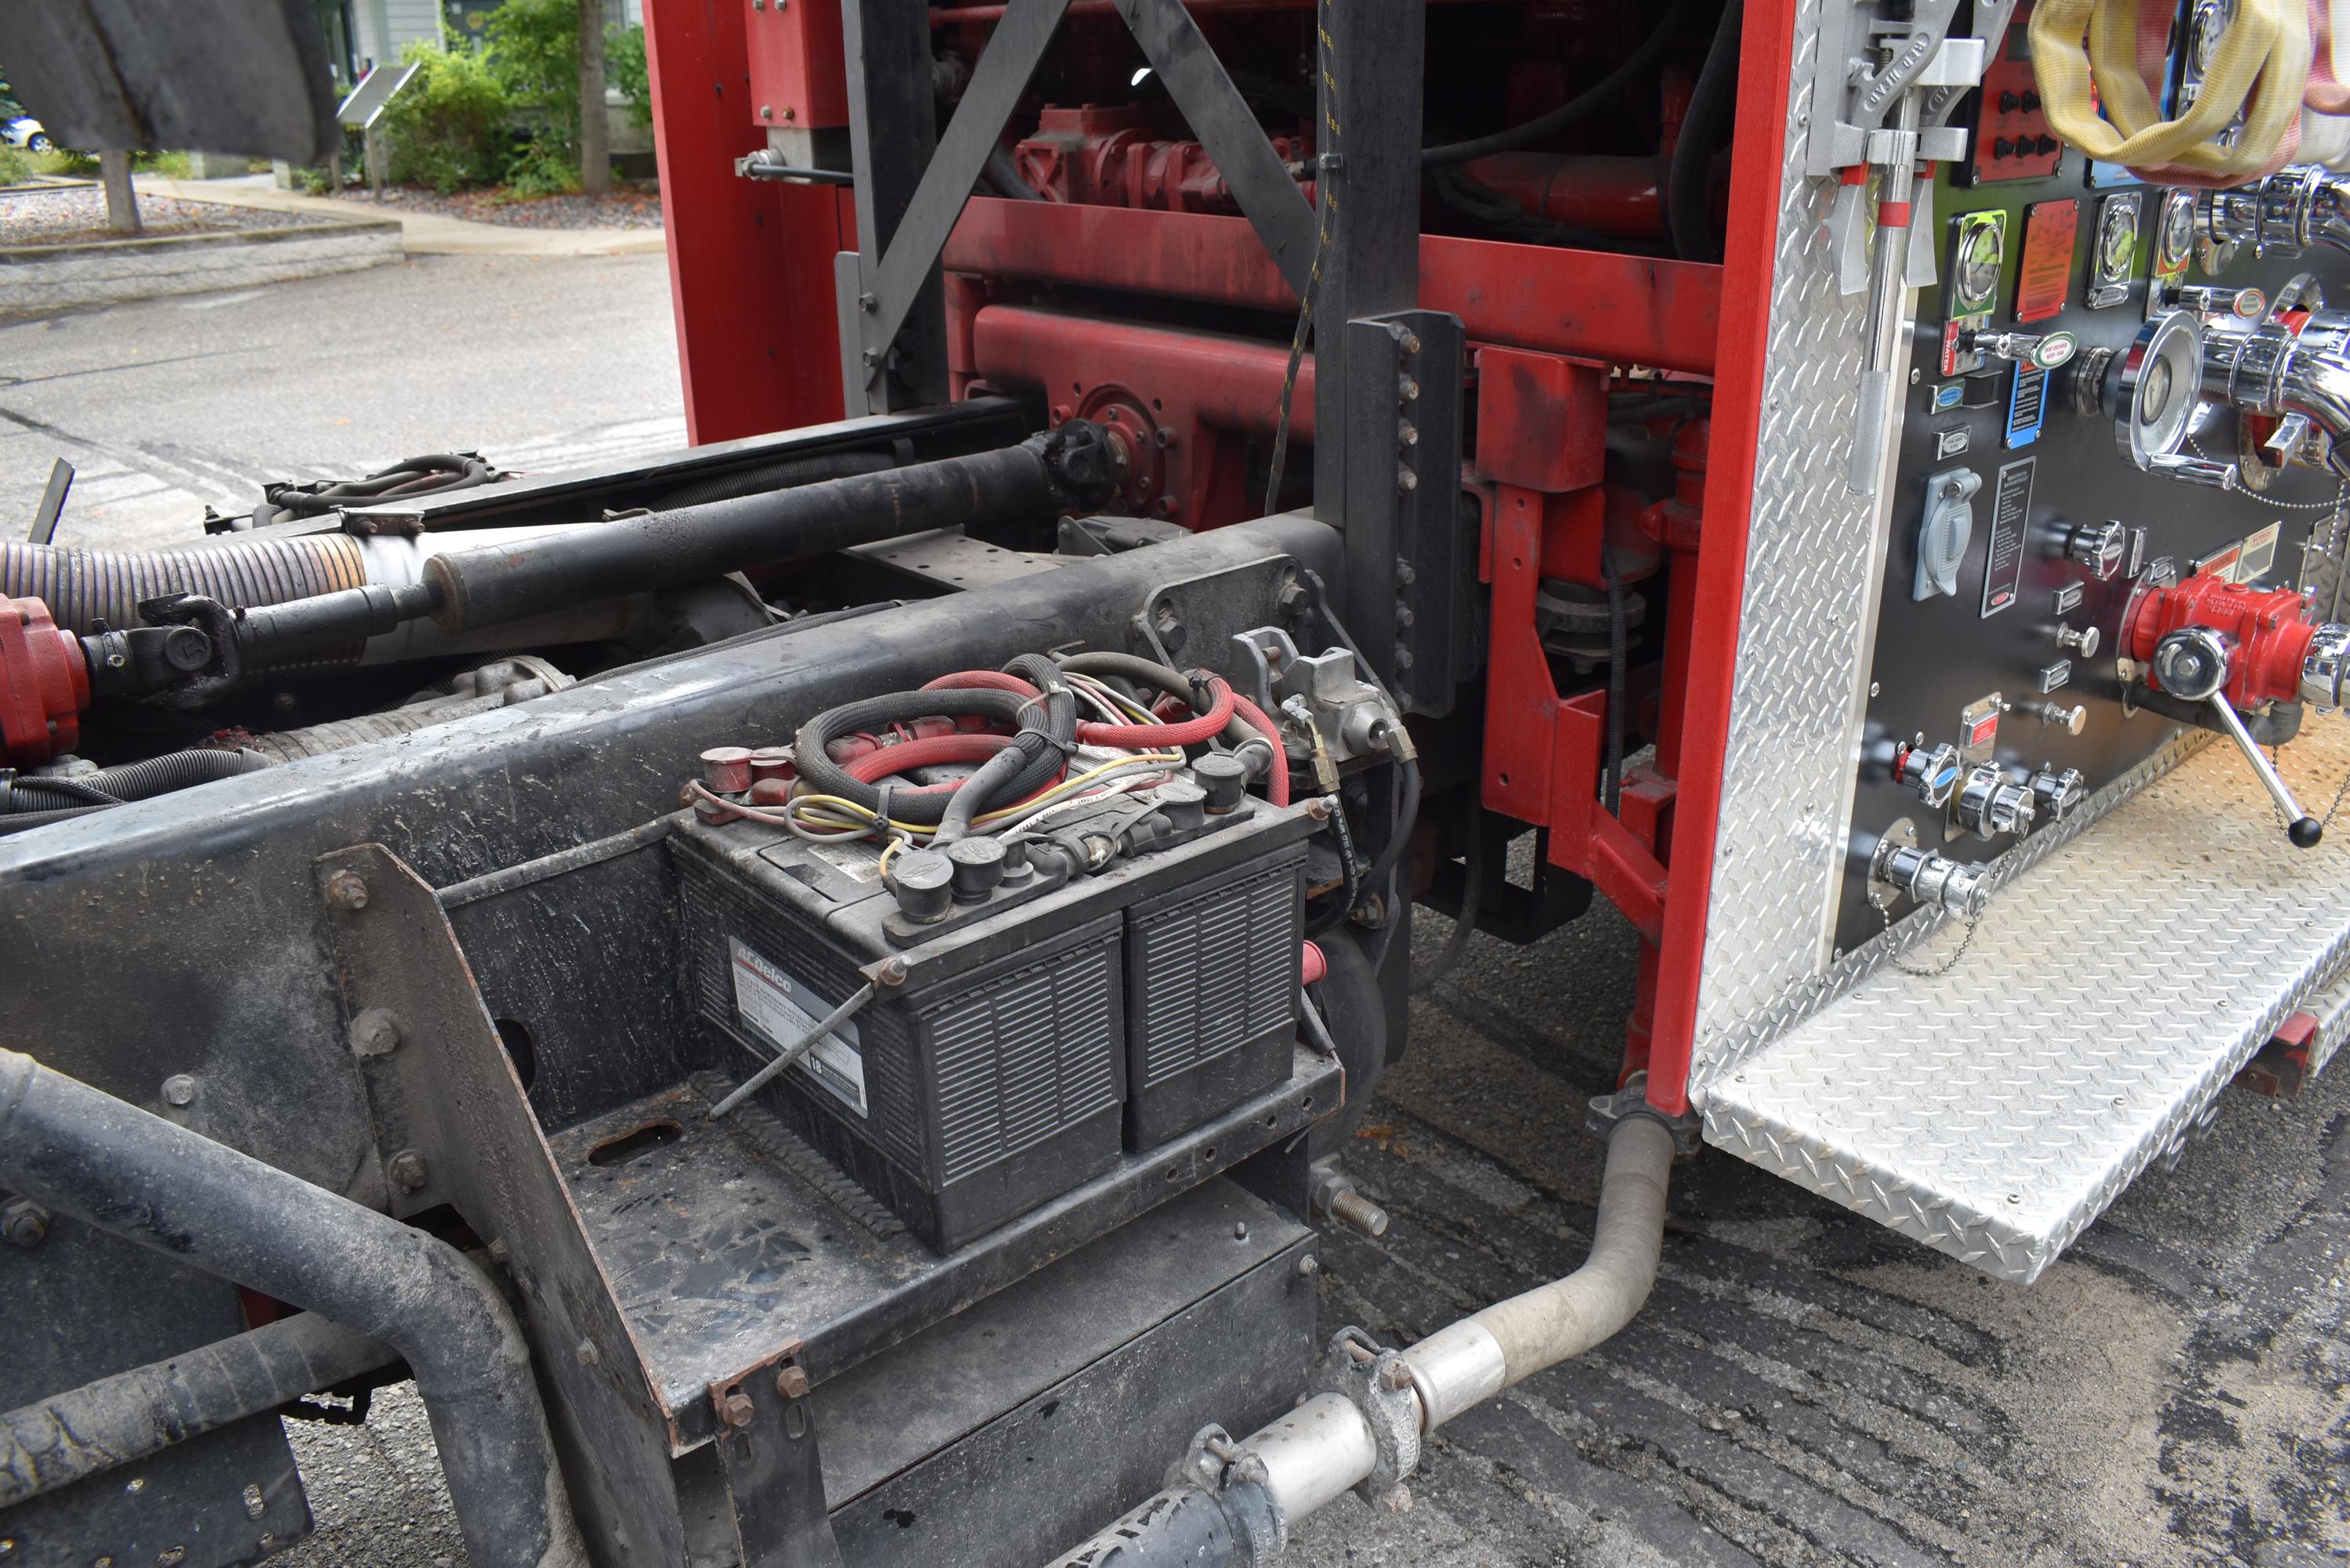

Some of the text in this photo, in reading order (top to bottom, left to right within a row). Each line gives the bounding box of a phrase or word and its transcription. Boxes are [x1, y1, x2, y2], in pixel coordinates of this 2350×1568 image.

[1869, 39, 1928, 103] RED HEAD
[737, 947, 792, 993] ACDelco
[810, 1056, 822, 1074] 18
